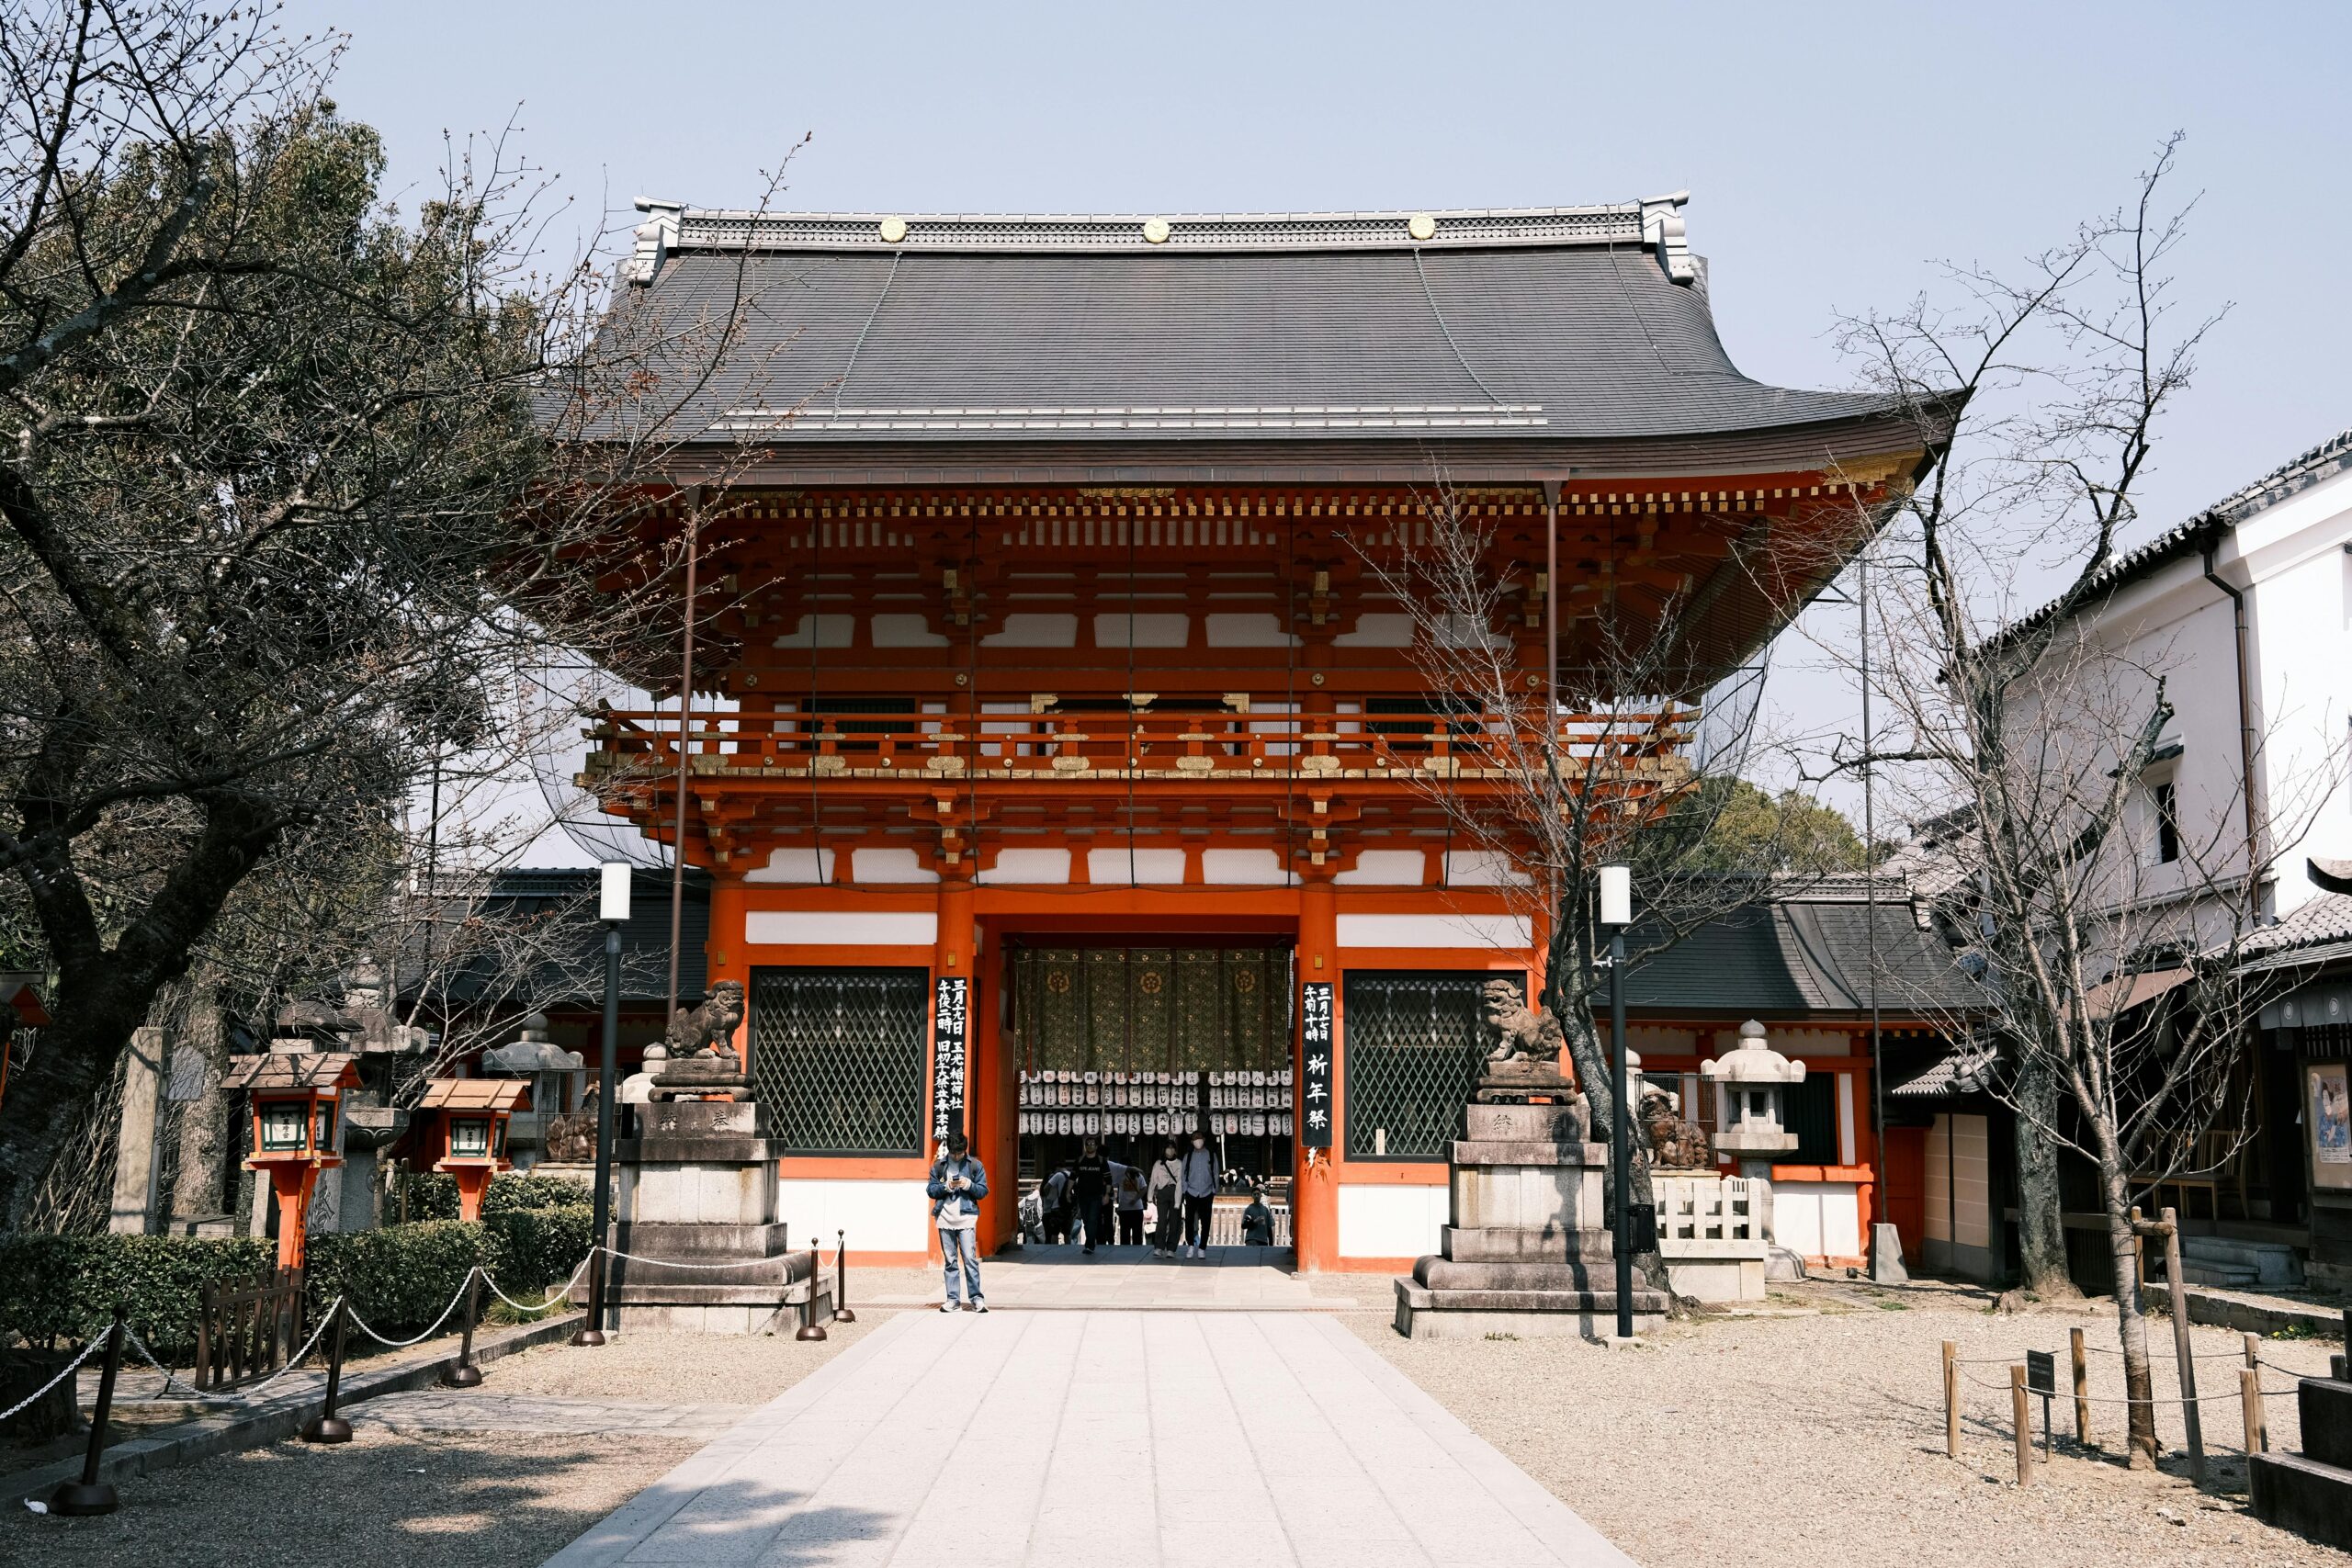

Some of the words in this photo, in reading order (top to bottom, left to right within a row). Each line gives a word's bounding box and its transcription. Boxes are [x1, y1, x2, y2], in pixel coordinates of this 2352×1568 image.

[937, 979, 953, 1034] 午後二時
[952, 979, 967, 1036] 三月十九日
[1305, 985, 1318, 1043] 午前十時
[1317, 987, 1331, 1041] 三月十七日
[1306, 1054, 1329, 1130] 祈年祭
